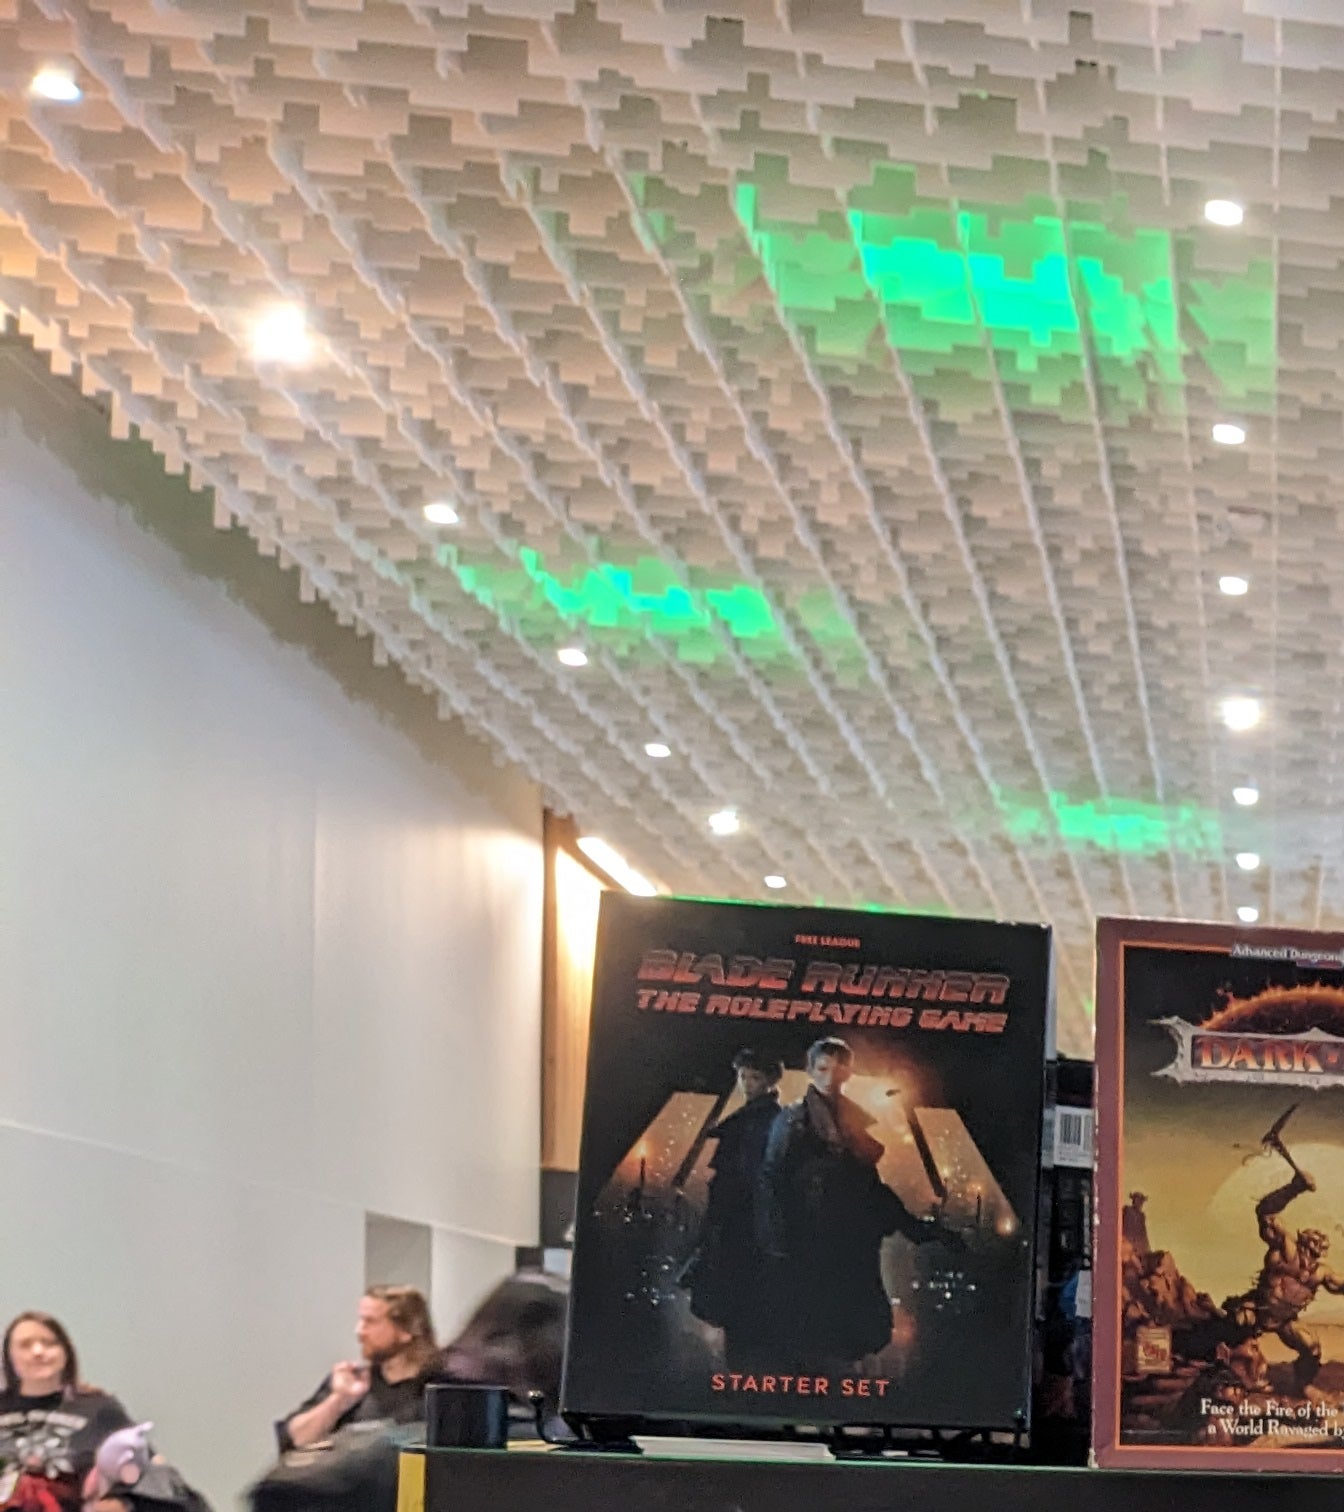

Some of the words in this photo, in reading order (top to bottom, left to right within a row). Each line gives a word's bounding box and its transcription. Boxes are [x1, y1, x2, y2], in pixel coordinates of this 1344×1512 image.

[1232, 944, 1287, 959] Advanced
[637, 949, 796, 992] BLADE
[803, 961, 1010, 1006] RUNNER
[636, 989, 697, 1013] THE
[706, 995, 914, 1028] ROLEPLAYING
[919, 1009, 1008, 1034] GAME
[1198, 1040, 1322, 1075] DARK
[712, 1374, 828, 1396] STARTER
[842, 1379, 890, 1397] SET
[1201, 1399, 1236, 1416] Face
[1240, 1402, 1262, 1416] the
[1265, 1400, 1293, 1418] Fire
[1297, 1402, 1311, 1418] of
[1315, 1403, 1338, 1418] the
[1208, 1424, 1216, 1434] a
[1220, 1419, 1263, 1435] World
[1267, 1421, 1329, 1439] Ravaged
